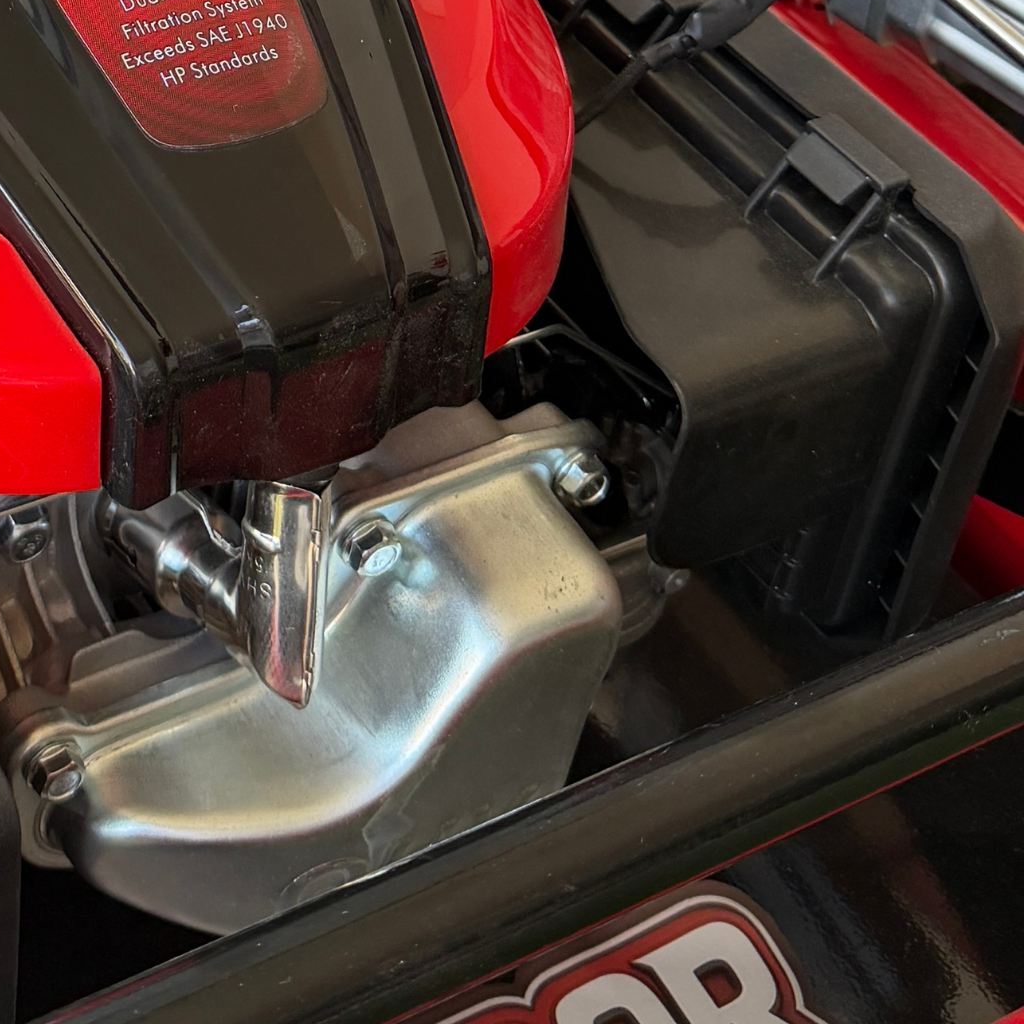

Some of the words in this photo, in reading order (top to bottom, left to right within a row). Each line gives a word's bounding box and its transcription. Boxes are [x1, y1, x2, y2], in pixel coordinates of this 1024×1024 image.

[120, 36, 195, 70] Exceeds
[196, 25, 232, 48] SAE
[235, 13, 288, 39] J1940
[121, 9, 204, 40] Filtration
[159, 66, 186, 88] HP
[189, 44, 279, 79] Standards
